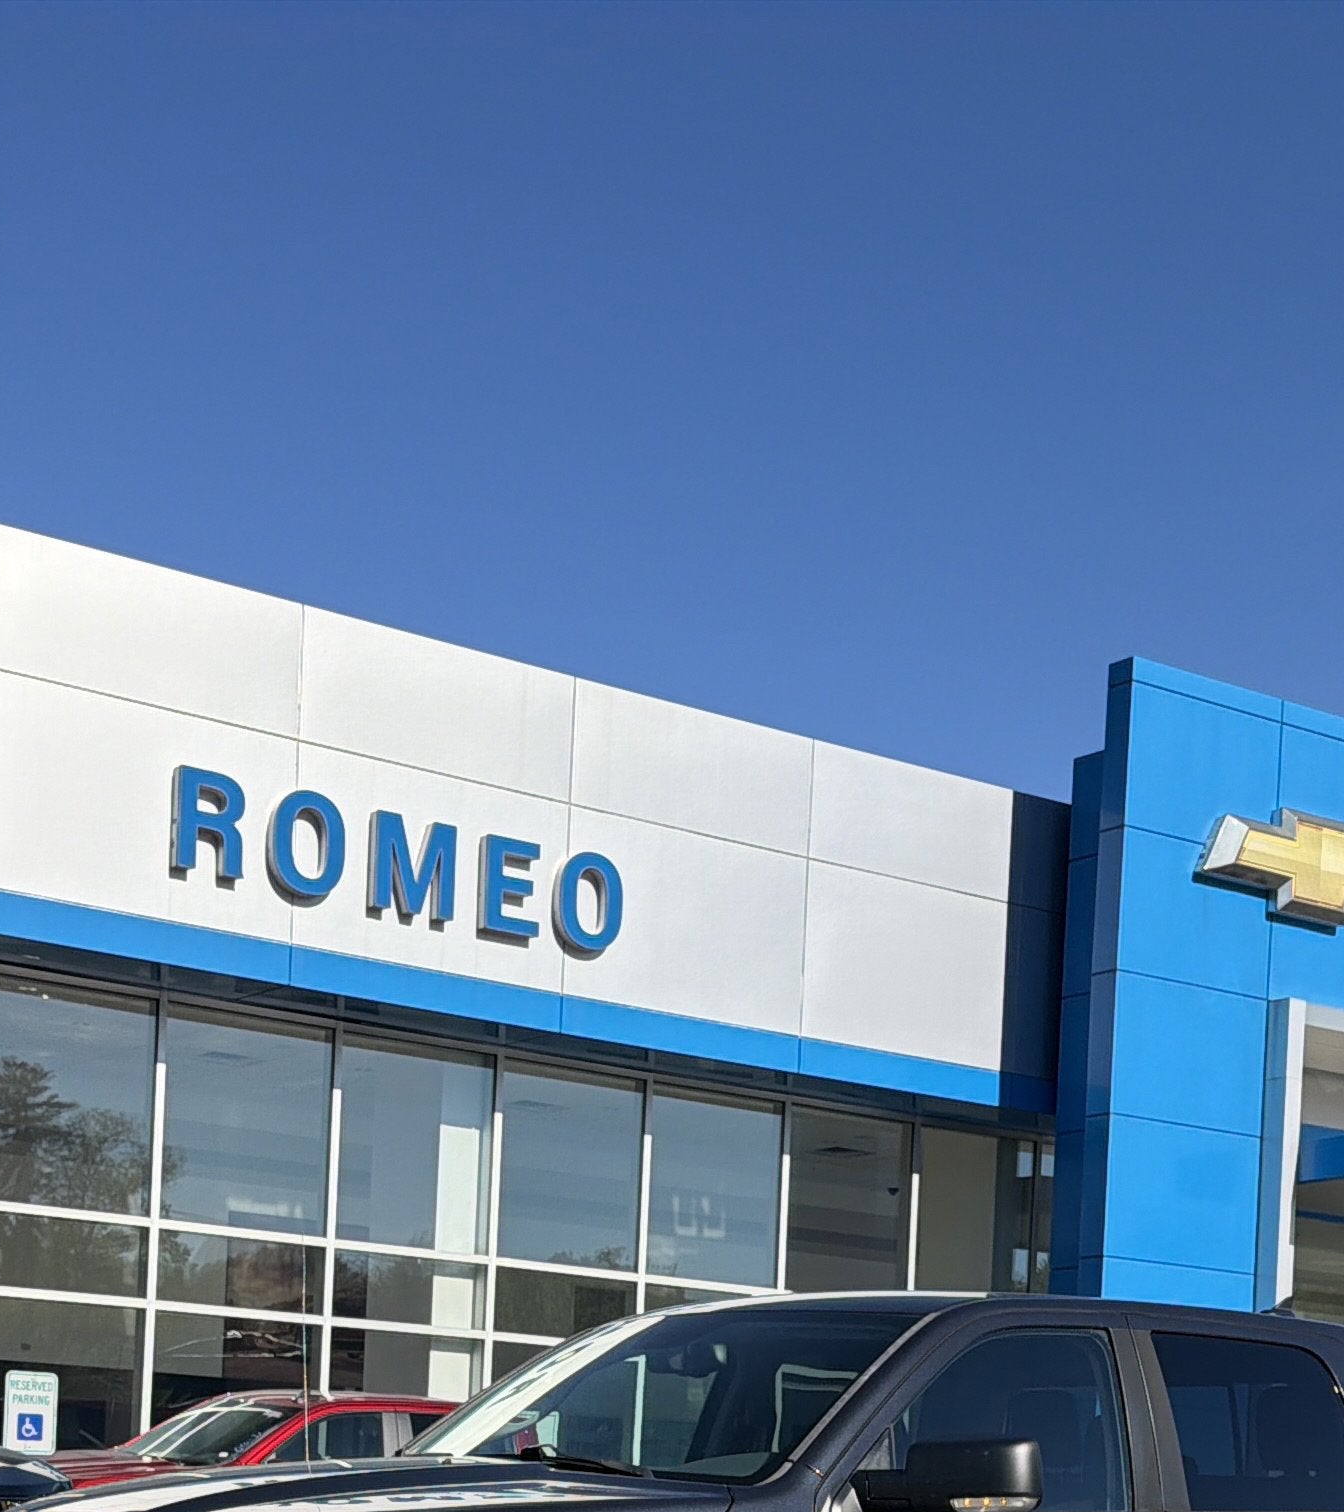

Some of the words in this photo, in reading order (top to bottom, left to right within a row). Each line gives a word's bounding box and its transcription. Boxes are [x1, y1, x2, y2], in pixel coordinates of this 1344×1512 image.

[169, 765, 623, 953] ROMEO
[10, 1379, 53, 1392] RESERVED
[12, 1394, 50, 1406] PARKING
